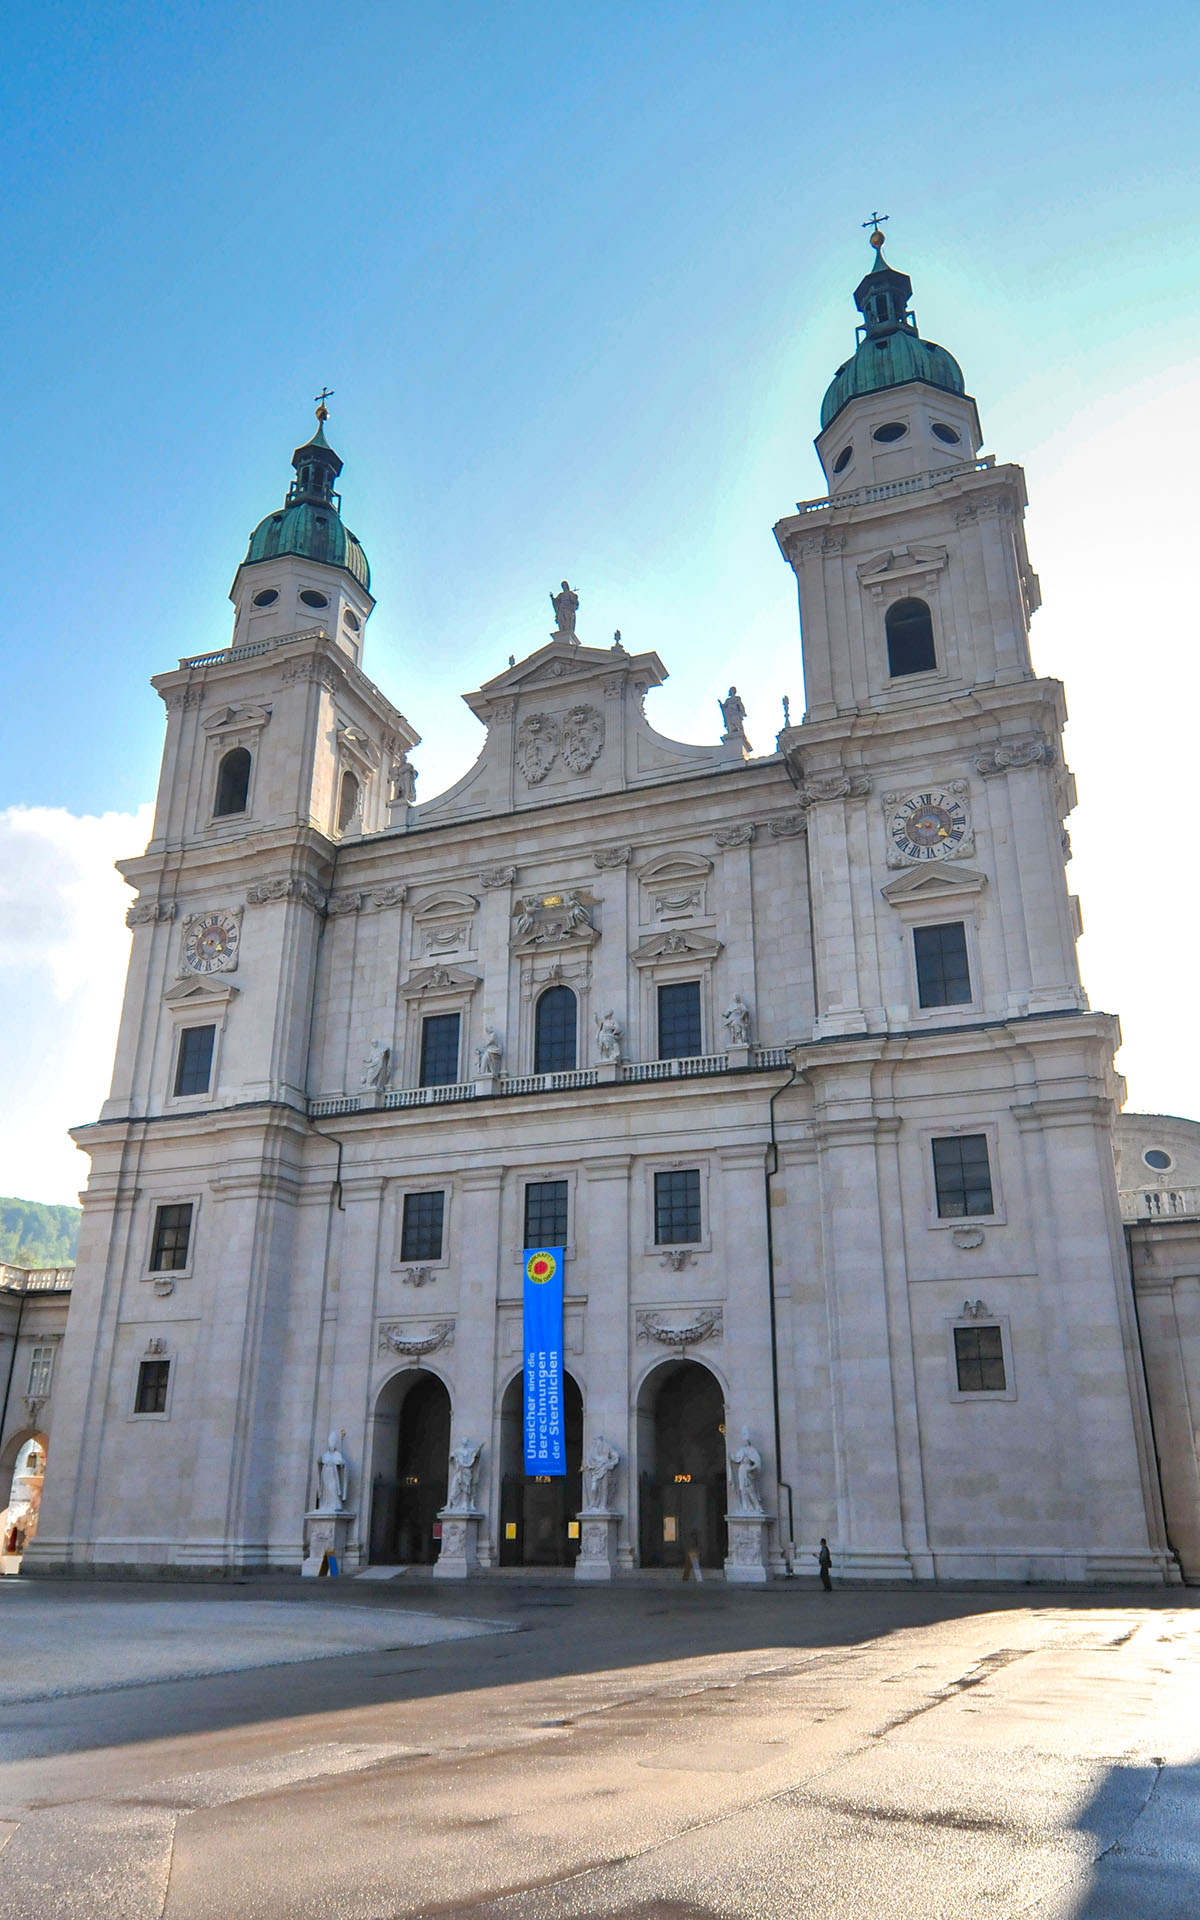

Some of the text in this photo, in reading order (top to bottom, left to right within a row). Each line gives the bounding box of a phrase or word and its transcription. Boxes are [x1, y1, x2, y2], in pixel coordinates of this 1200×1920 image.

[528, 1370, 536, 1392] sind
[537, 1351, 548, 1459] Berechnungen
[548, 1351, 560, 1459] der Sterblichen
[526, 1396, 537, 1459] Unsicher
